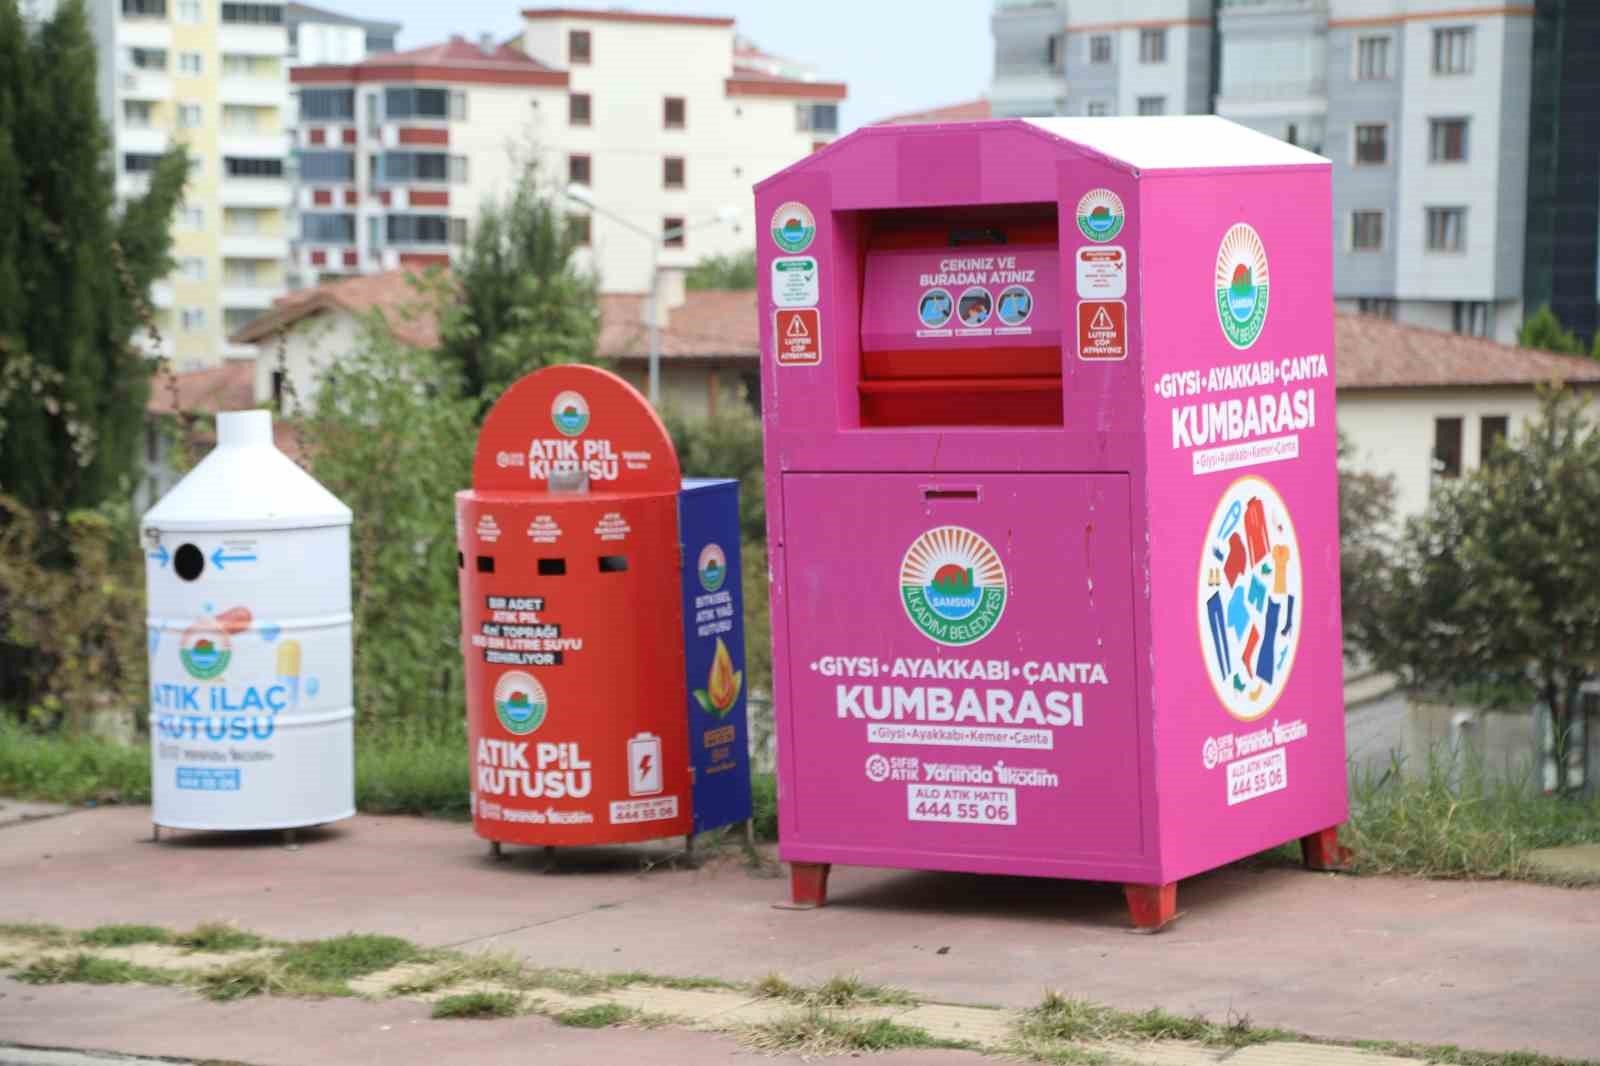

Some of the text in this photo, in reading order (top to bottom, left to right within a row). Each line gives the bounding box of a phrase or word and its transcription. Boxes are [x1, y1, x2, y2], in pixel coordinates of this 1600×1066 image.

[997, 257, 1016, 268] VE
[920, 272, 987, 286] BURADAN
[1207, 360, 1274, 392] AYAKKABI
[1281, 354, 1328, 386] ÇANTA
[1172, 388, 1316, 449] KUMBARASI
[529, 439, 579, 460] ATIK
[508, 598, 543, 611] ADET
[544, 638, 583, 651] SUYU
[891, 658, 1010, 681] AYAKKABI
[1022, 661, 1109, 685] ÇANTA
[836, 685, 1084, 727] KUMBARASI
[477, 738, 529, 768] ATIK
[478, 766, 592, 798] KUTUSU
[916, 789, 1009, 802] ALO ATIK HATTI
[915, 801, 1009, 820] 444 55 06
